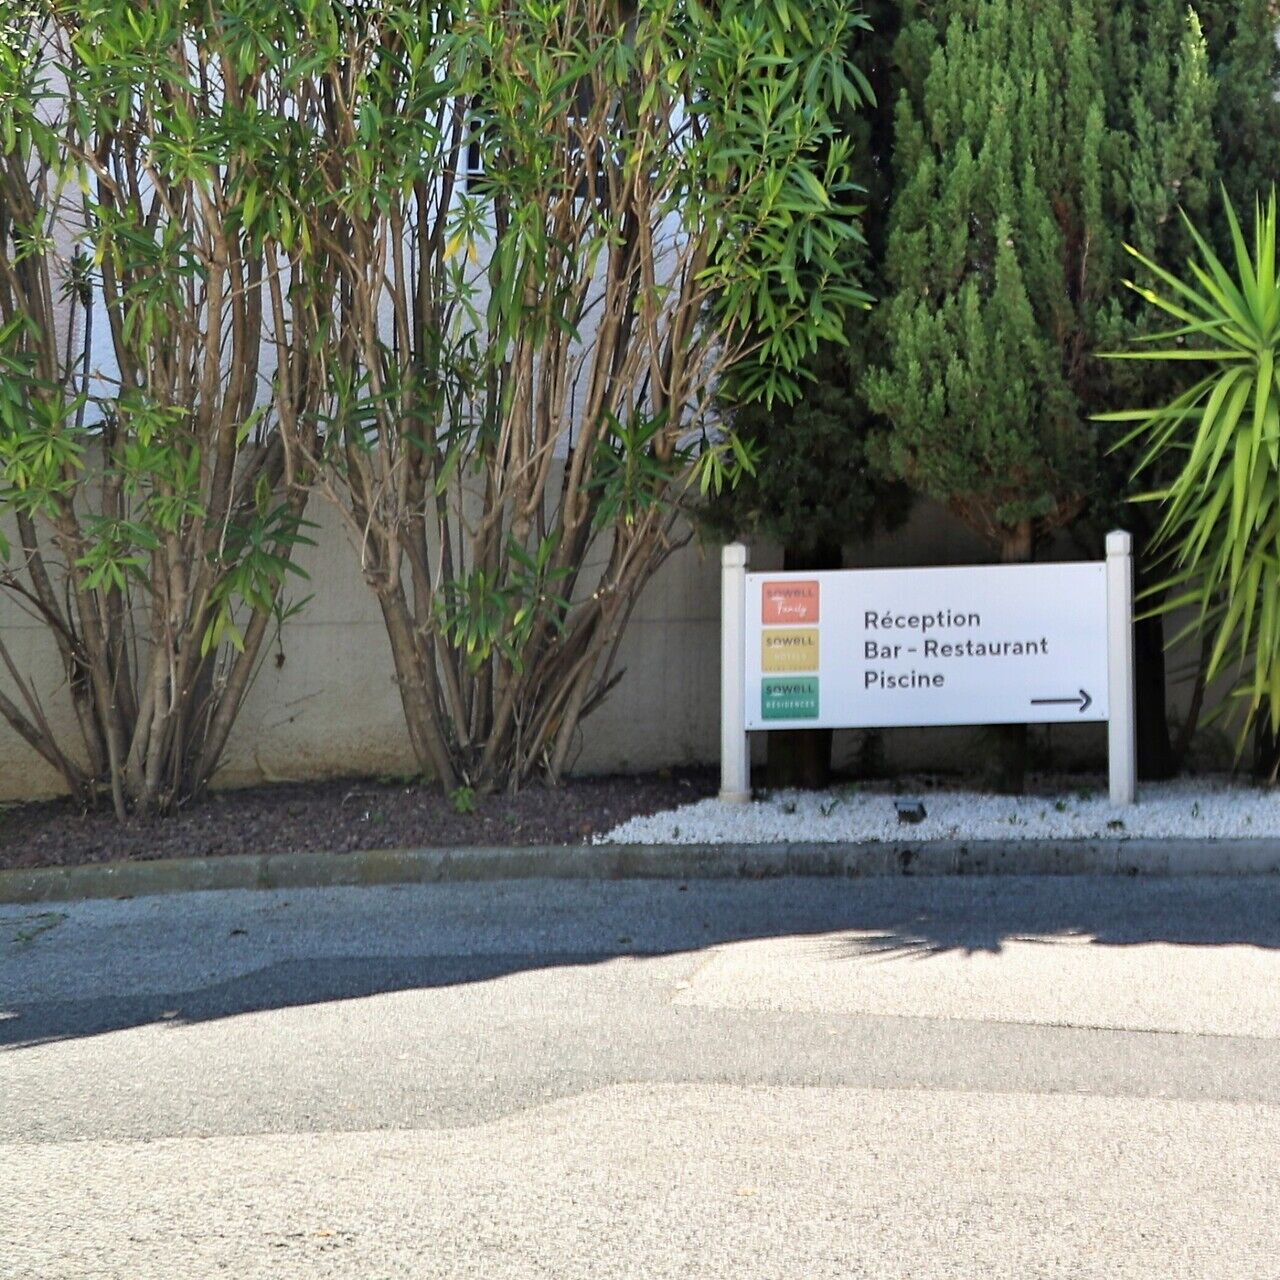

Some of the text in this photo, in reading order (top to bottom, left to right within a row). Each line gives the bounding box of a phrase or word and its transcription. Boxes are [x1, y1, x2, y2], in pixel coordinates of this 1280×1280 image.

[864, 609, 982, 634] Réception
[864, 640, 902, 660] Bar
[924, 637, 1050, 659] Restaurant
[864, 669, 946, 690] Piscine
